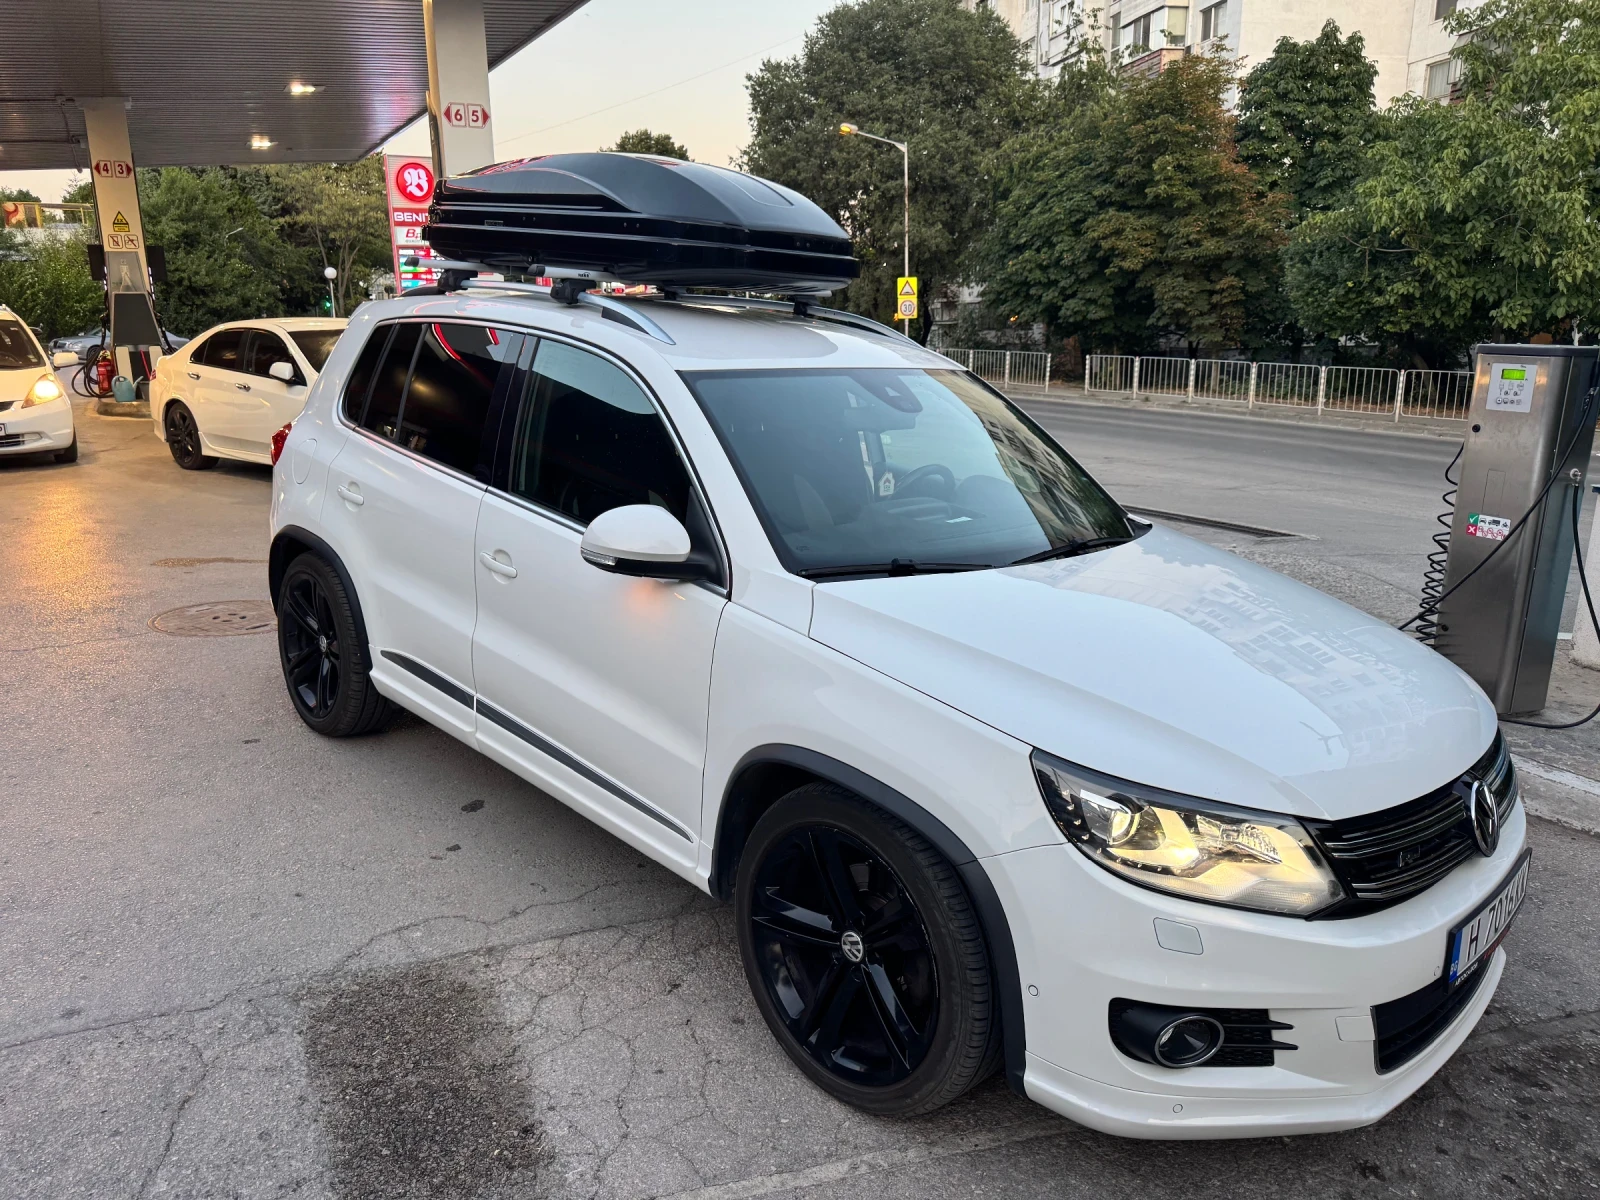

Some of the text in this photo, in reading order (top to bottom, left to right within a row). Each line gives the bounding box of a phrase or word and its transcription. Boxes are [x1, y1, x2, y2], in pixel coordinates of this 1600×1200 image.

[454, 108, 479, 123] 6 5
[102, 163, 124, 174] 4 3
[903, 304, 912, 312] 30
[1466, 916, 1481, 962] H
